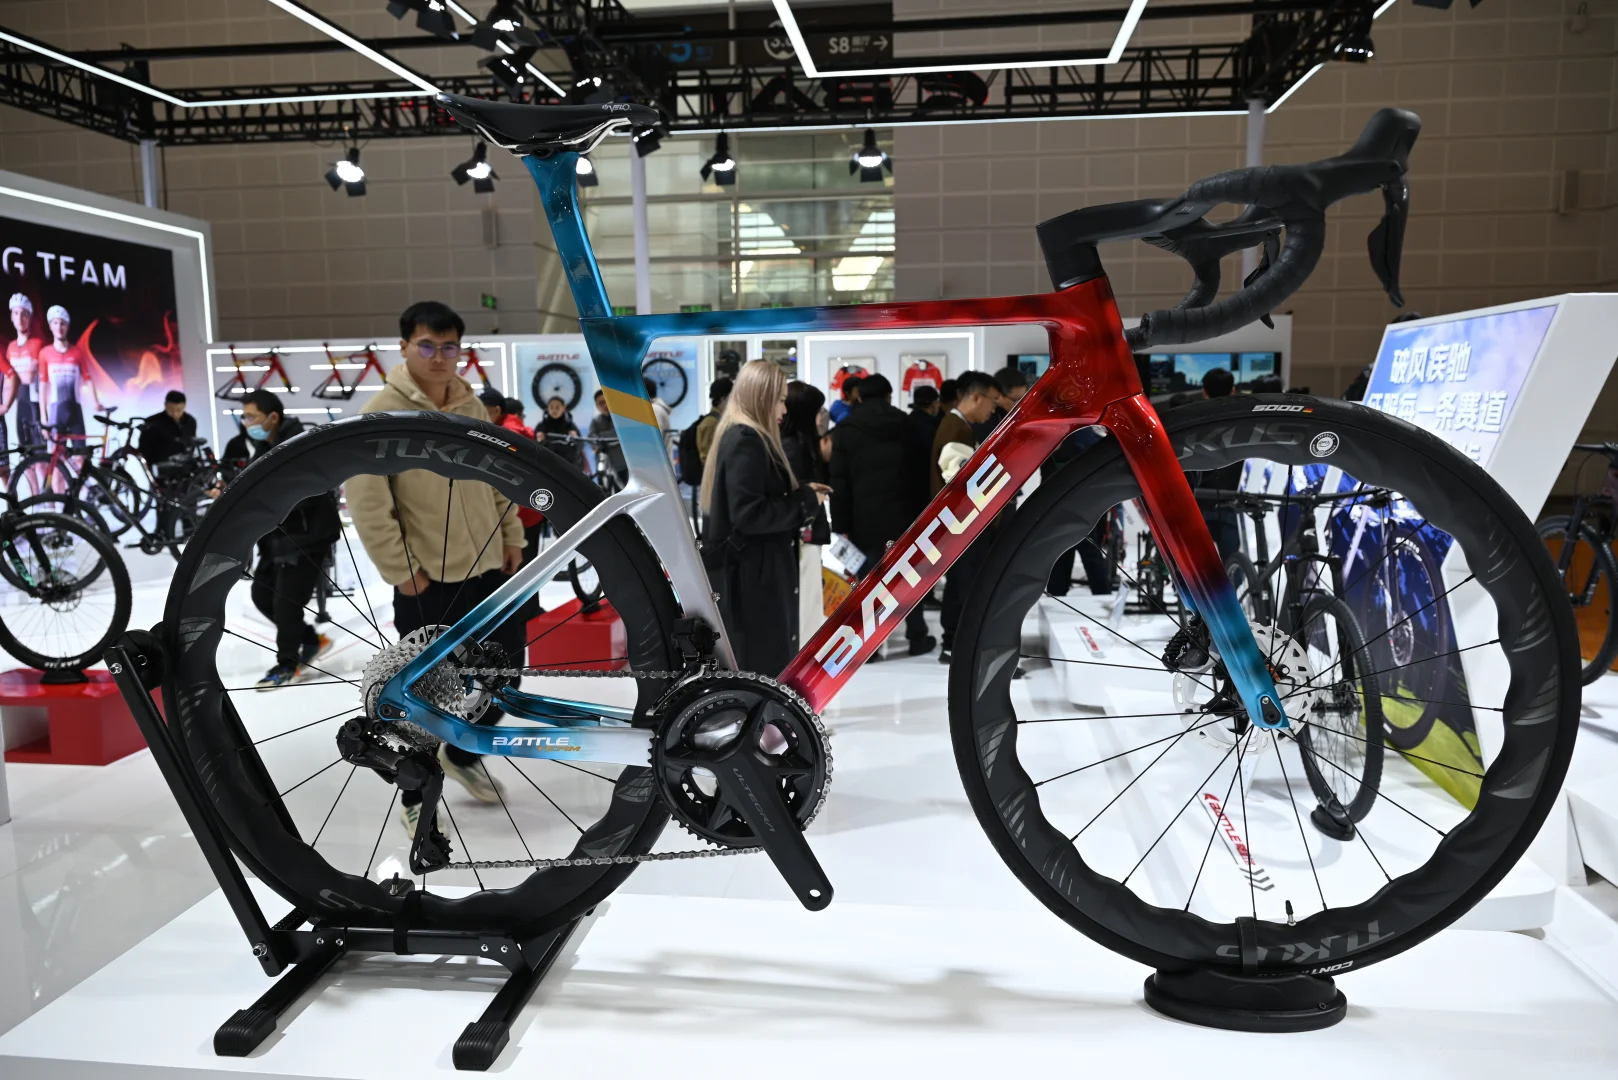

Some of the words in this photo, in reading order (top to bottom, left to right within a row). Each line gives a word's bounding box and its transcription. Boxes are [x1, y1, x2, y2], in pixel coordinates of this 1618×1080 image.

[829, 37, 849, 54] S8
[1389, 341, 1472, 384] 破风疾驰
[1251, 404, 1305, 413] 5000
[466, 429, 512, 449] 5000
[365, 437, 533, 486] TUKUS
[814, 453, 1011, 679] BATTLE
[492, 736, 570, 746] BATTLE
